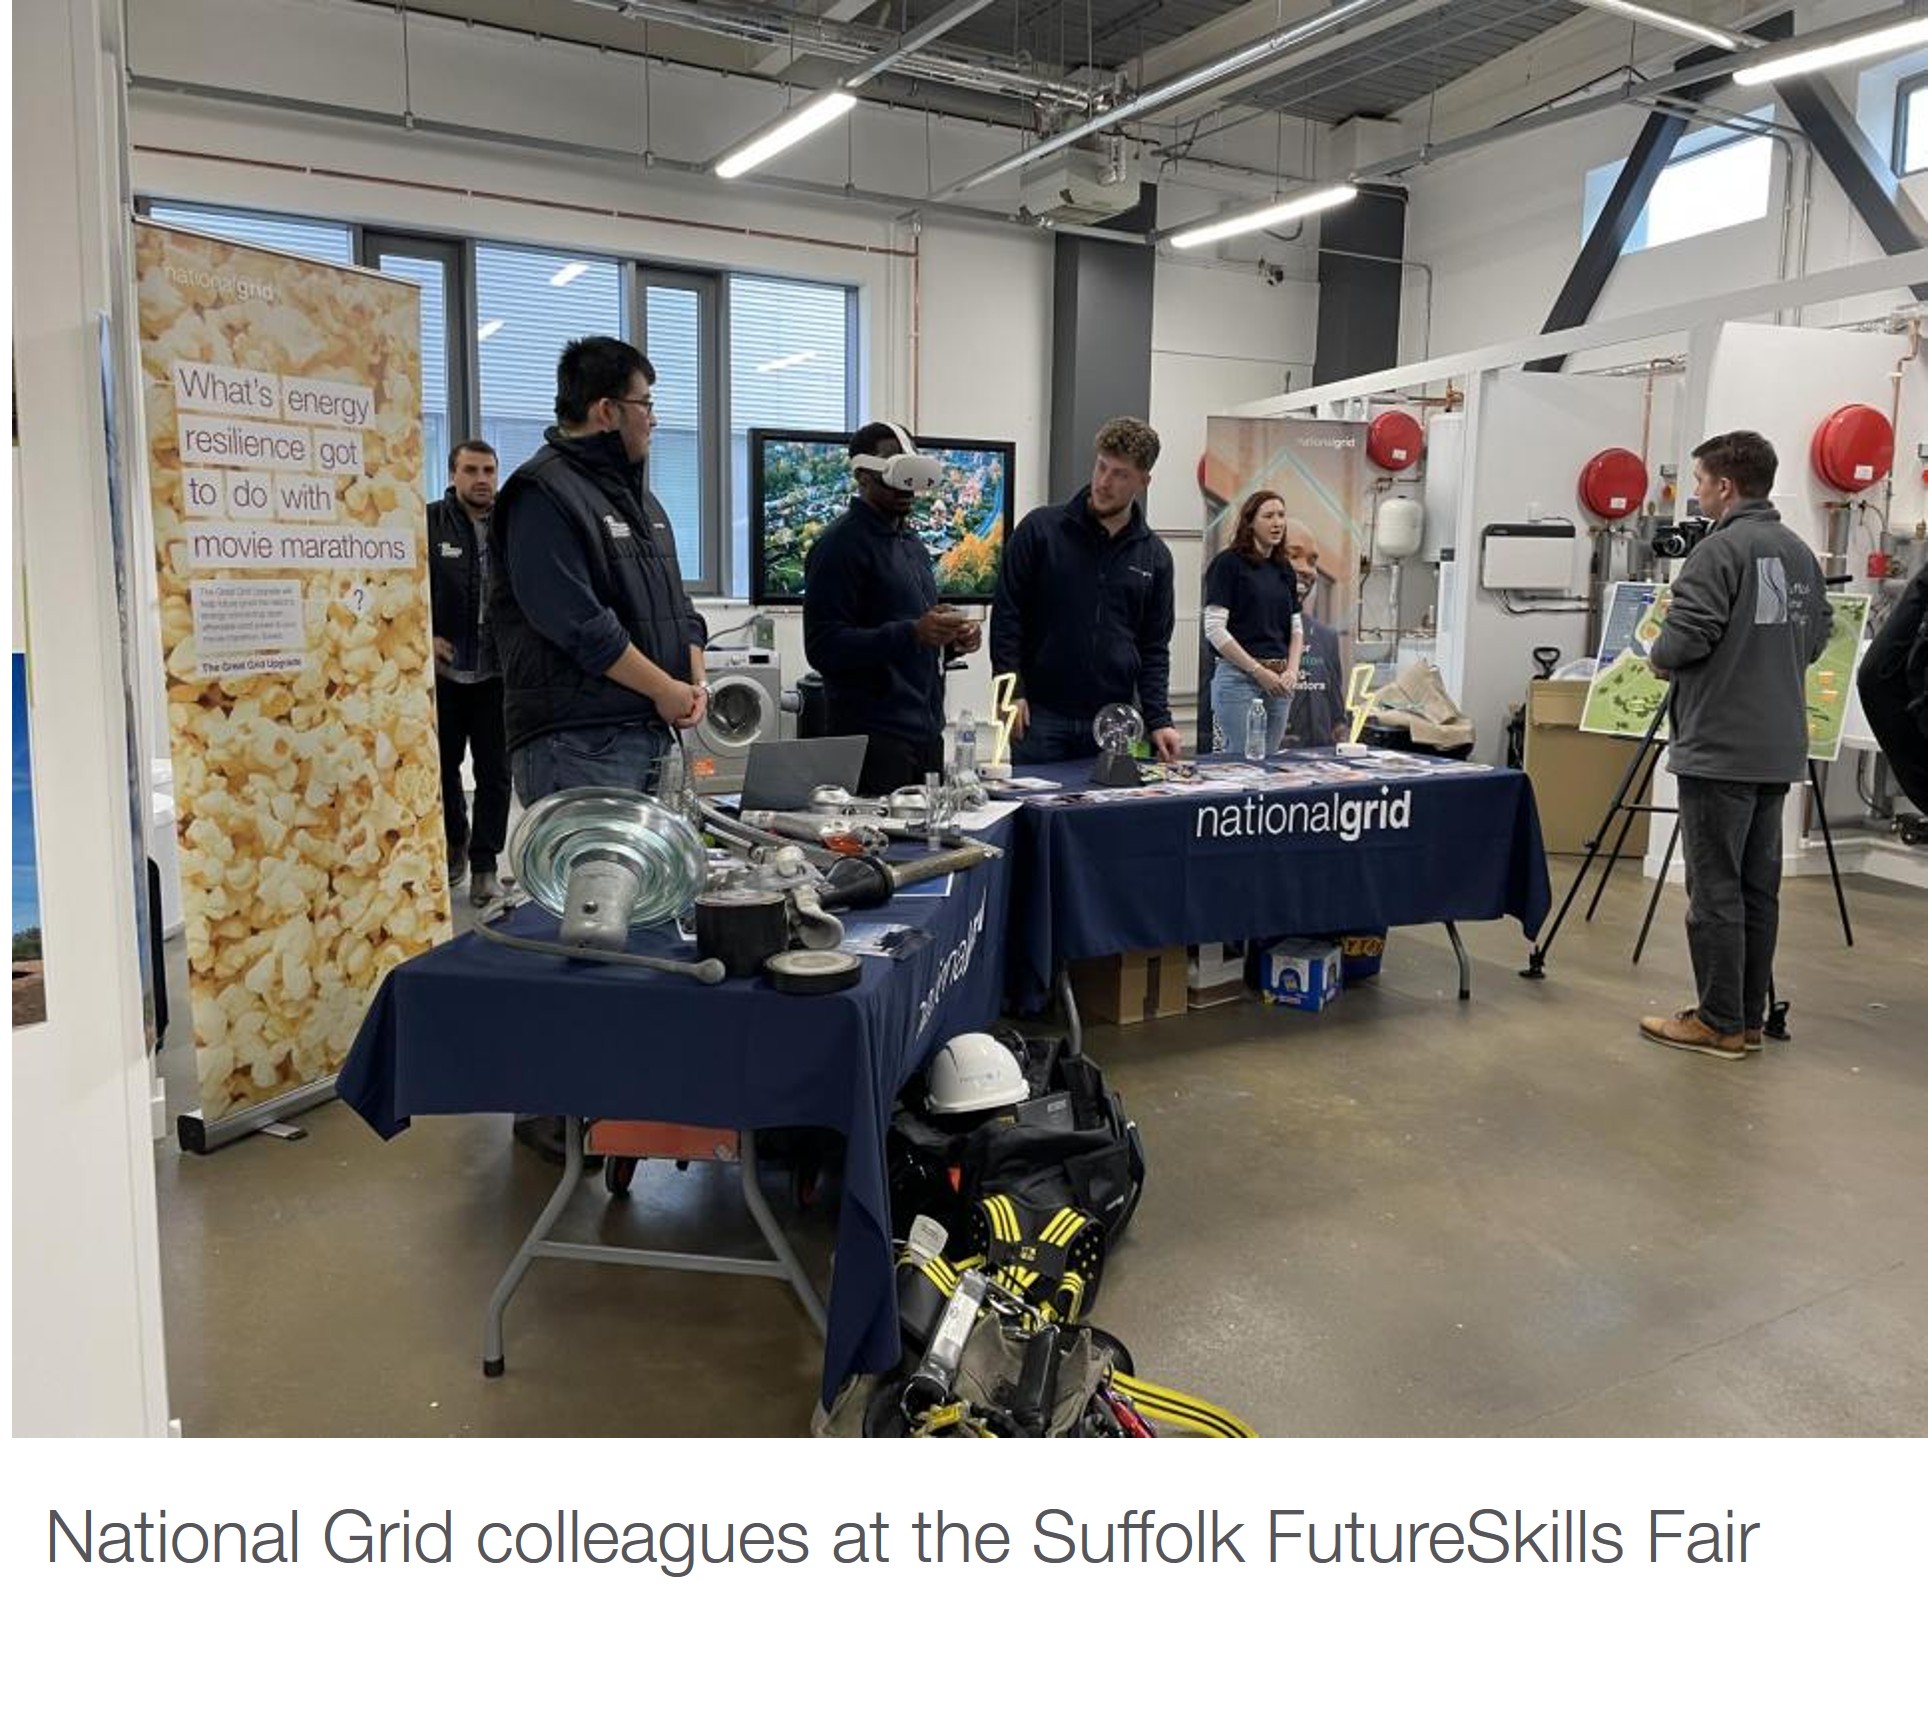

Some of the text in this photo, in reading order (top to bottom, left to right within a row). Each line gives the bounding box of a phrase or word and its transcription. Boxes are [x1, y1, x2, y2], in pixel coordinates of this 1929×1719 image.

[179, 367, 370, 426] What's energy
[185, 425, 359, 470] resilience got
[188, 477, 332, 511] to do with
[193, 531, 406, 561] movie marathons
[353, 588, 365, 612] ?
[1196, 784, 1412, 842] nationalgrid
